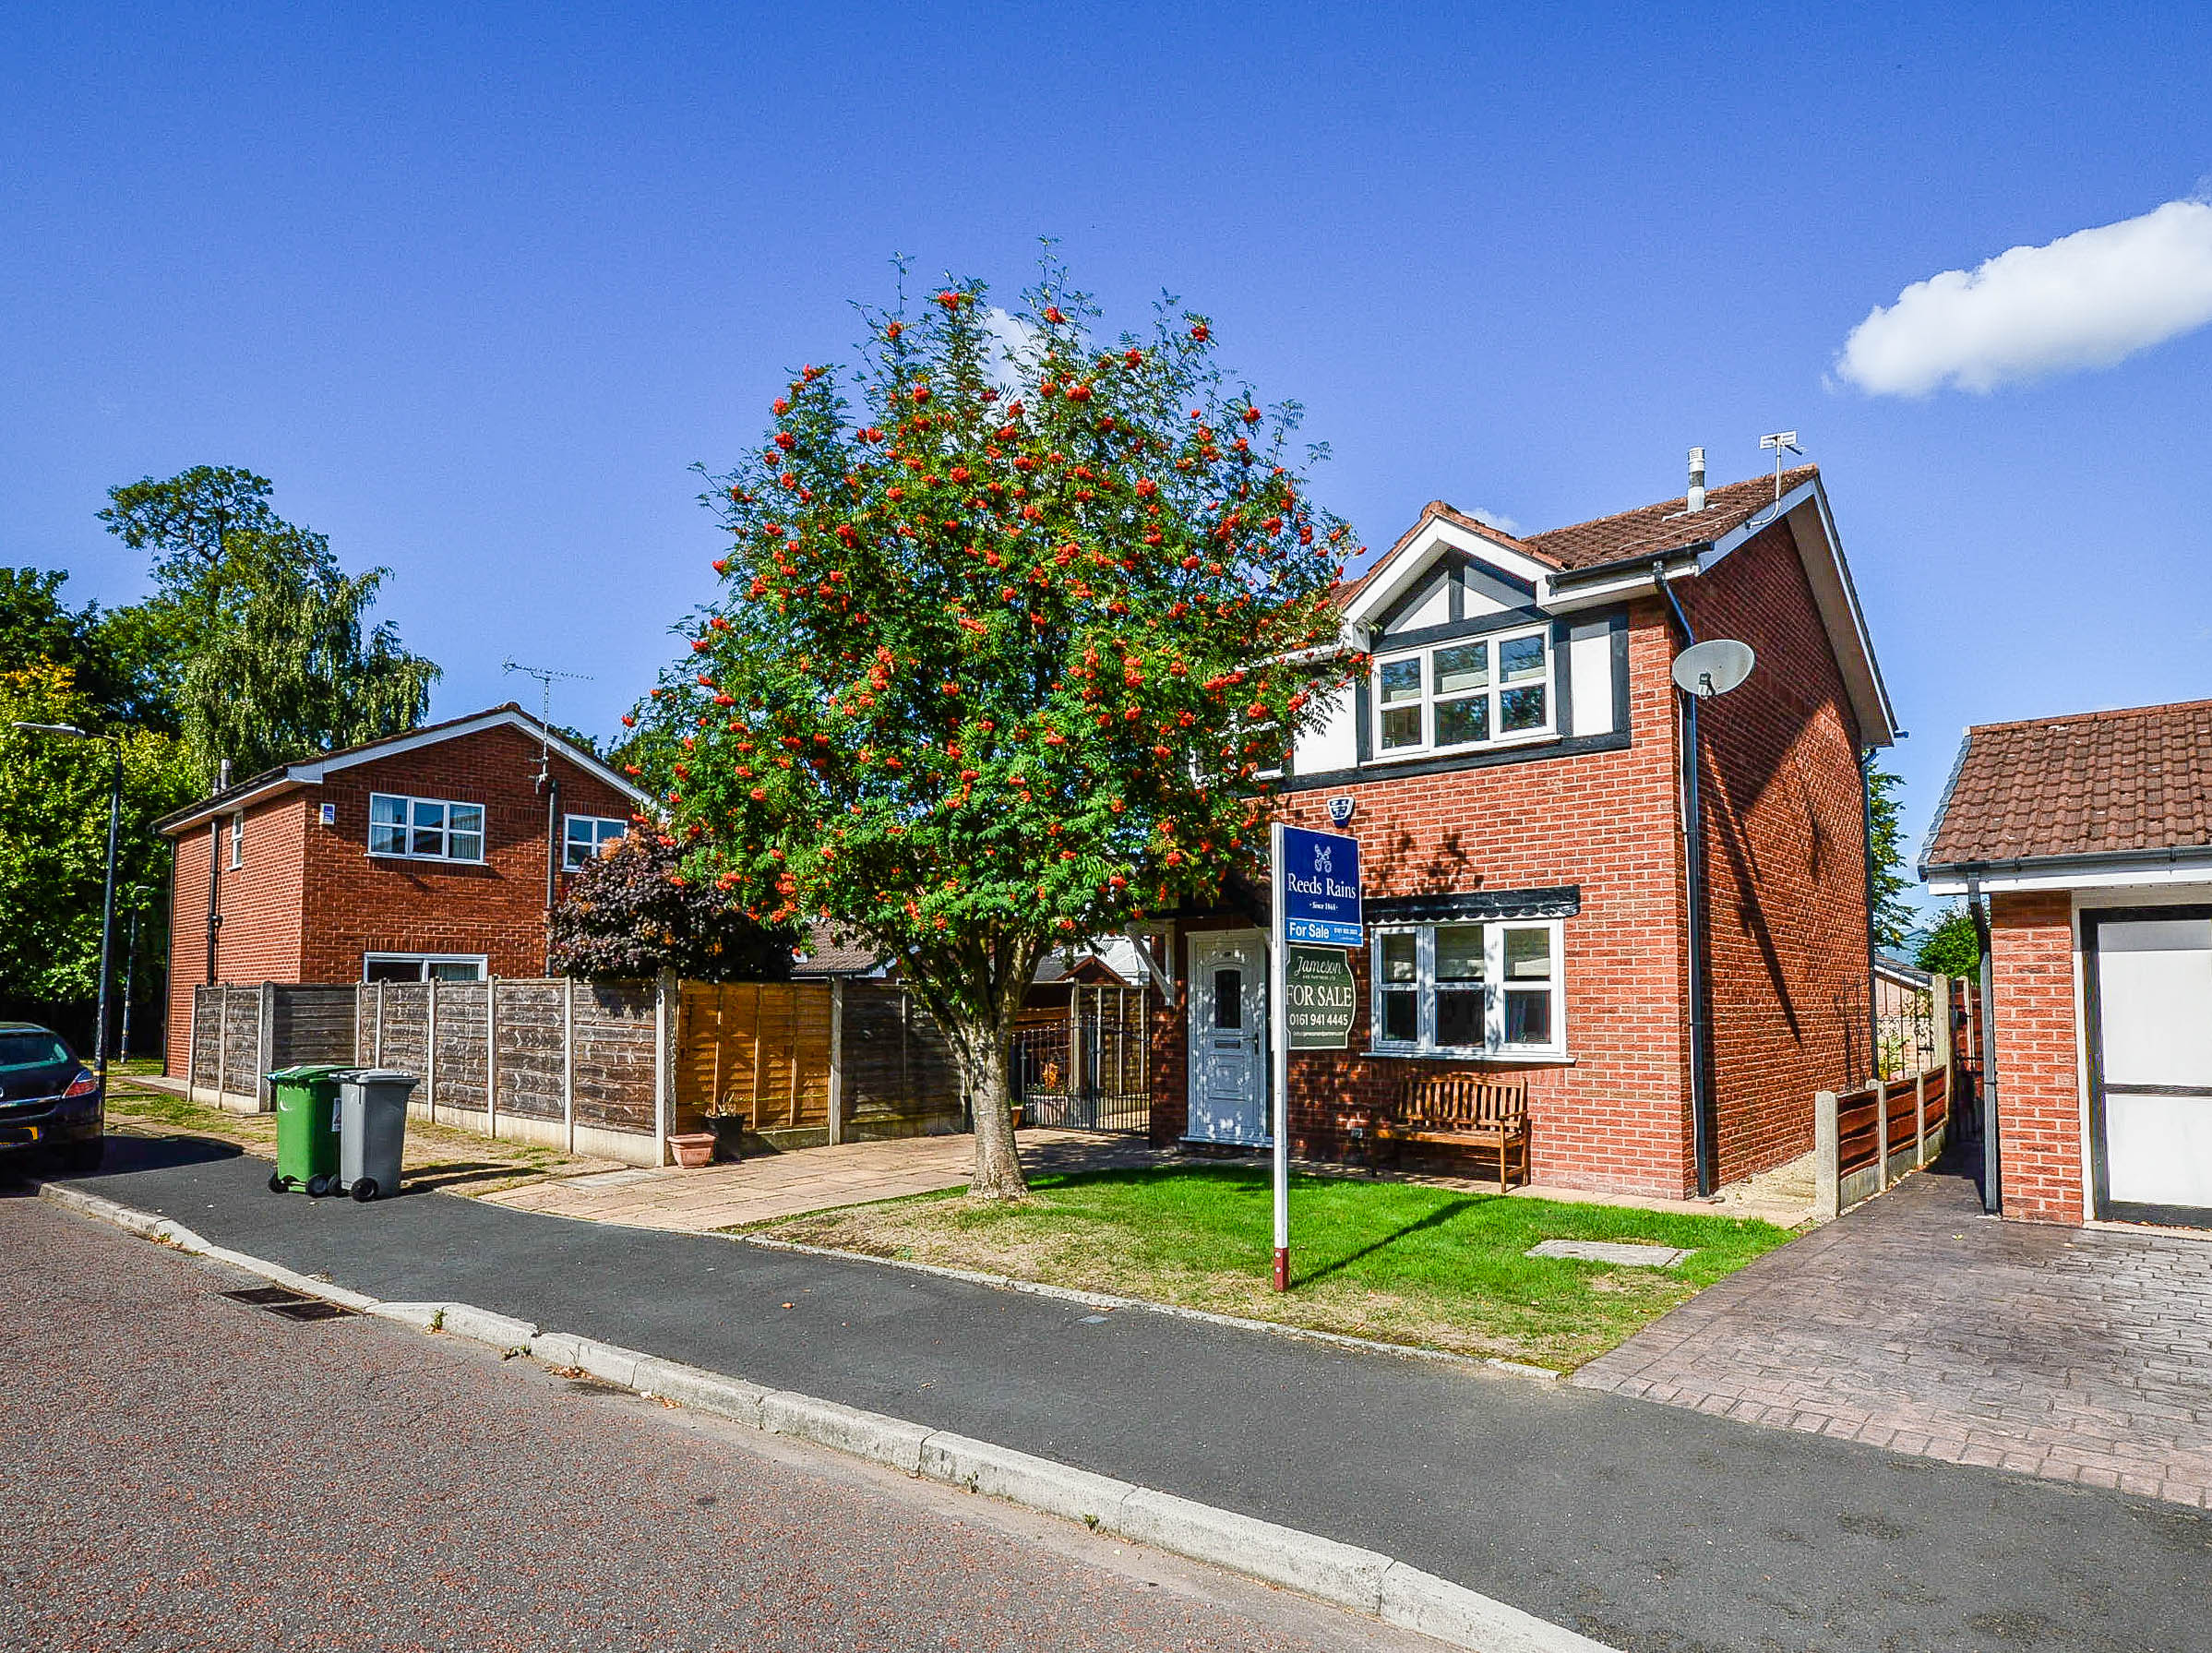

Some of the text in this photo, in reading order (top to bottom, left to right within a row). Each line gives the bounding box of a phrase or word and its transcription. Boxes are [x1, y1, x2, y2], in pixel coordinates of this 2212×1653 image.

[1287, 873, 1357, 900] Reeds Rains
[1289, 921, 1307, 937] For
[1309, 923, 1330, 940] Sale
[1294, 955, 1344, 976] Jameson
[1286, 984, 1353, 1007] FOR SALE
[1289, 1013, 1348, 1026] 0161 941 4445
